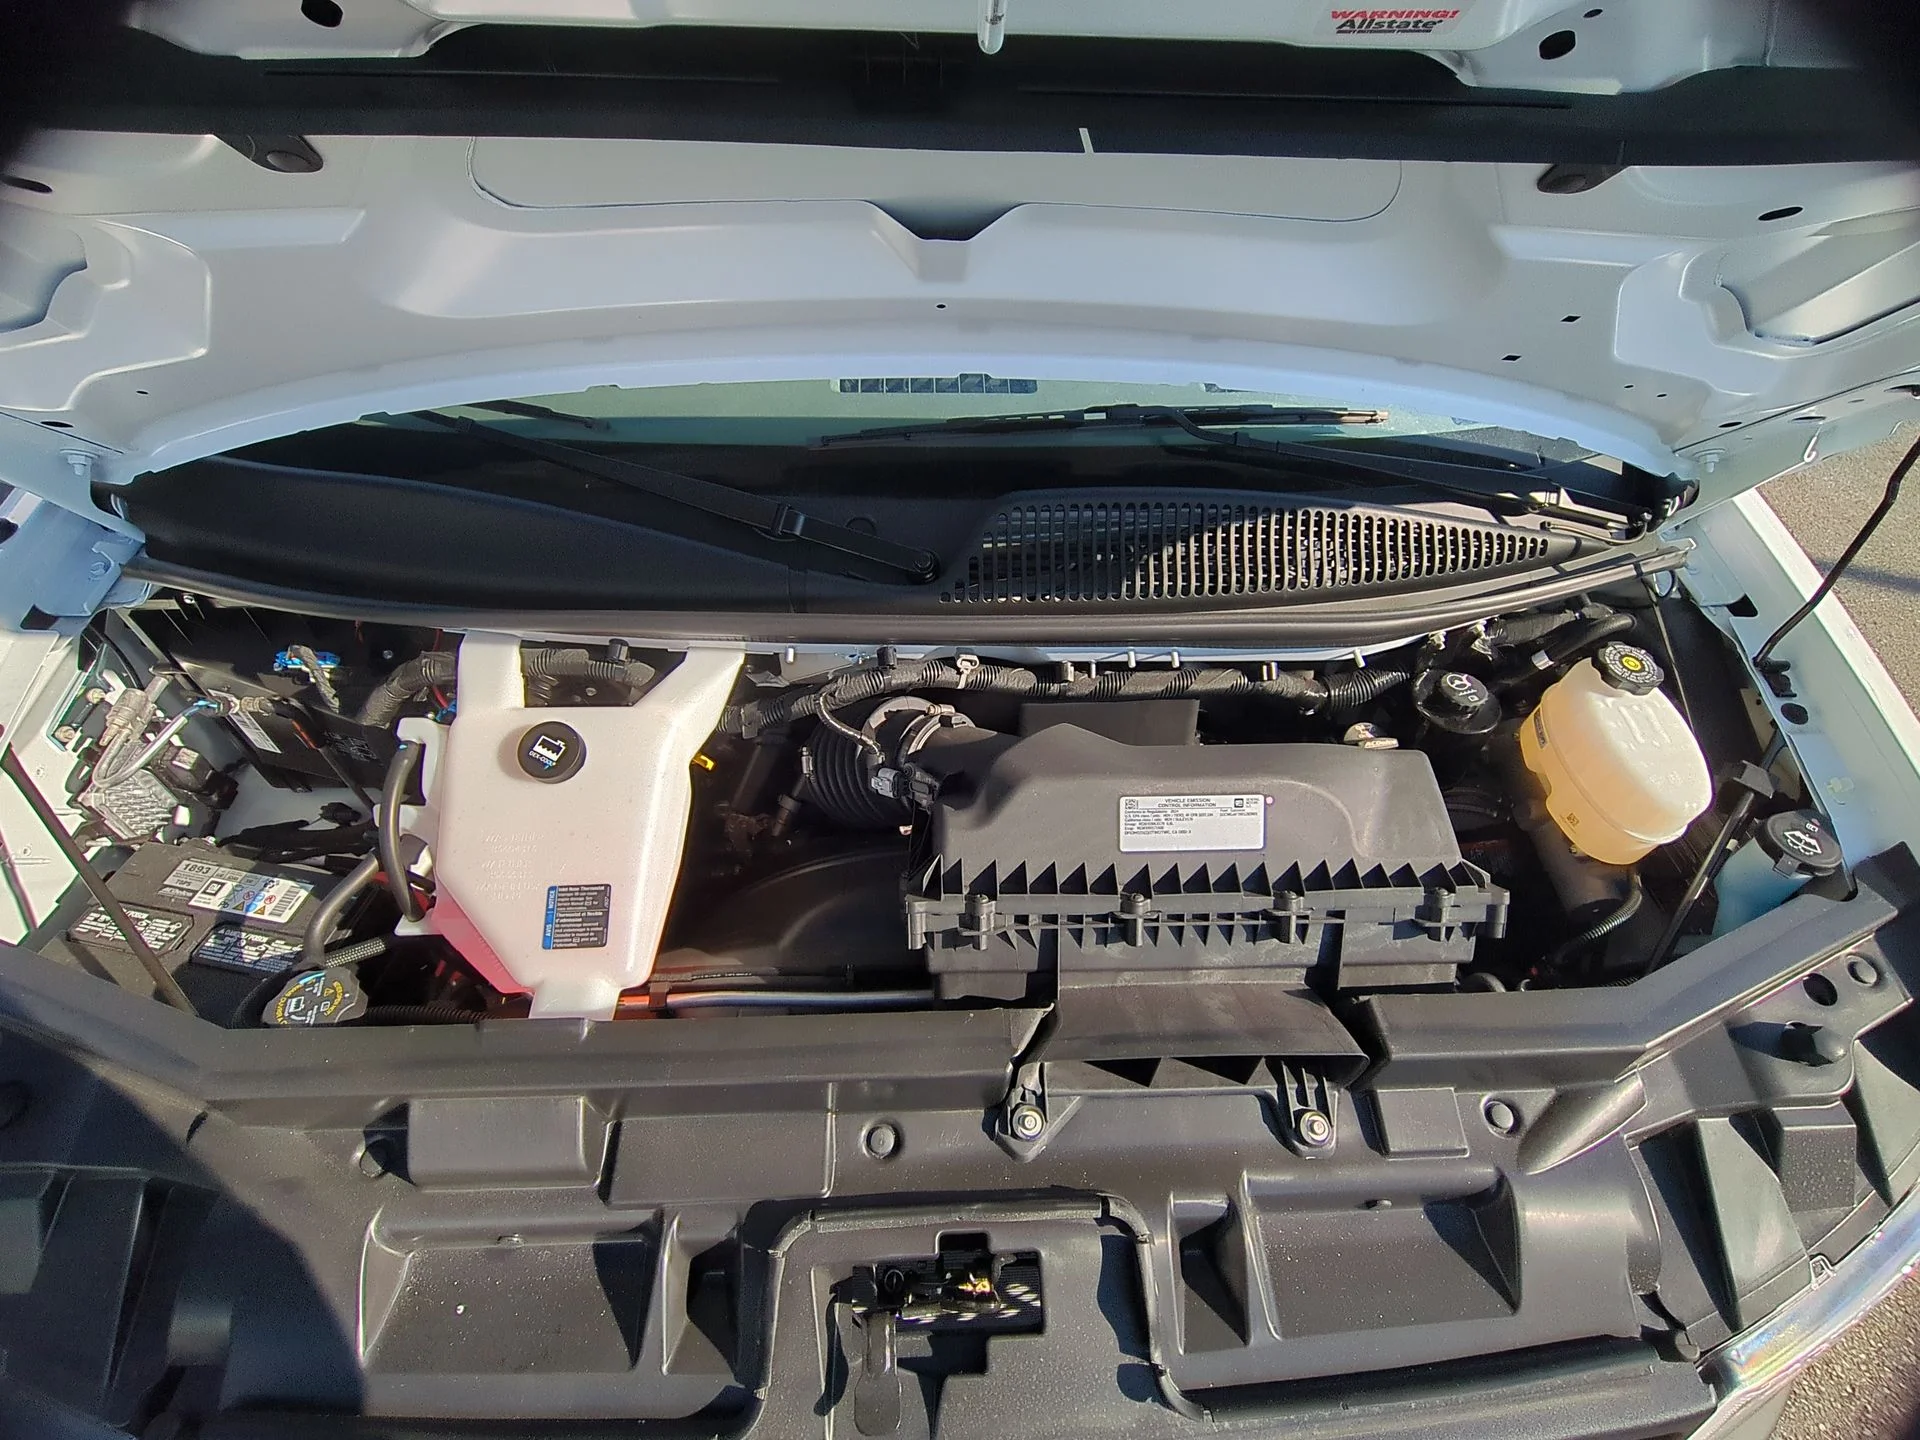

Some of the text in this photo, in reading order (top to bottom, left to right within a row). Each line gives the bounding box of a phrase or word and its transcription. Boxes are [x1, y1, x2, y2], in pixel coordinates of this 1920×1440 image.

[1331, 10, 1460, 19] WARNING!
[1336, 19, 1439, 30] Allstate
[183, 862, 212, 875] 1893
